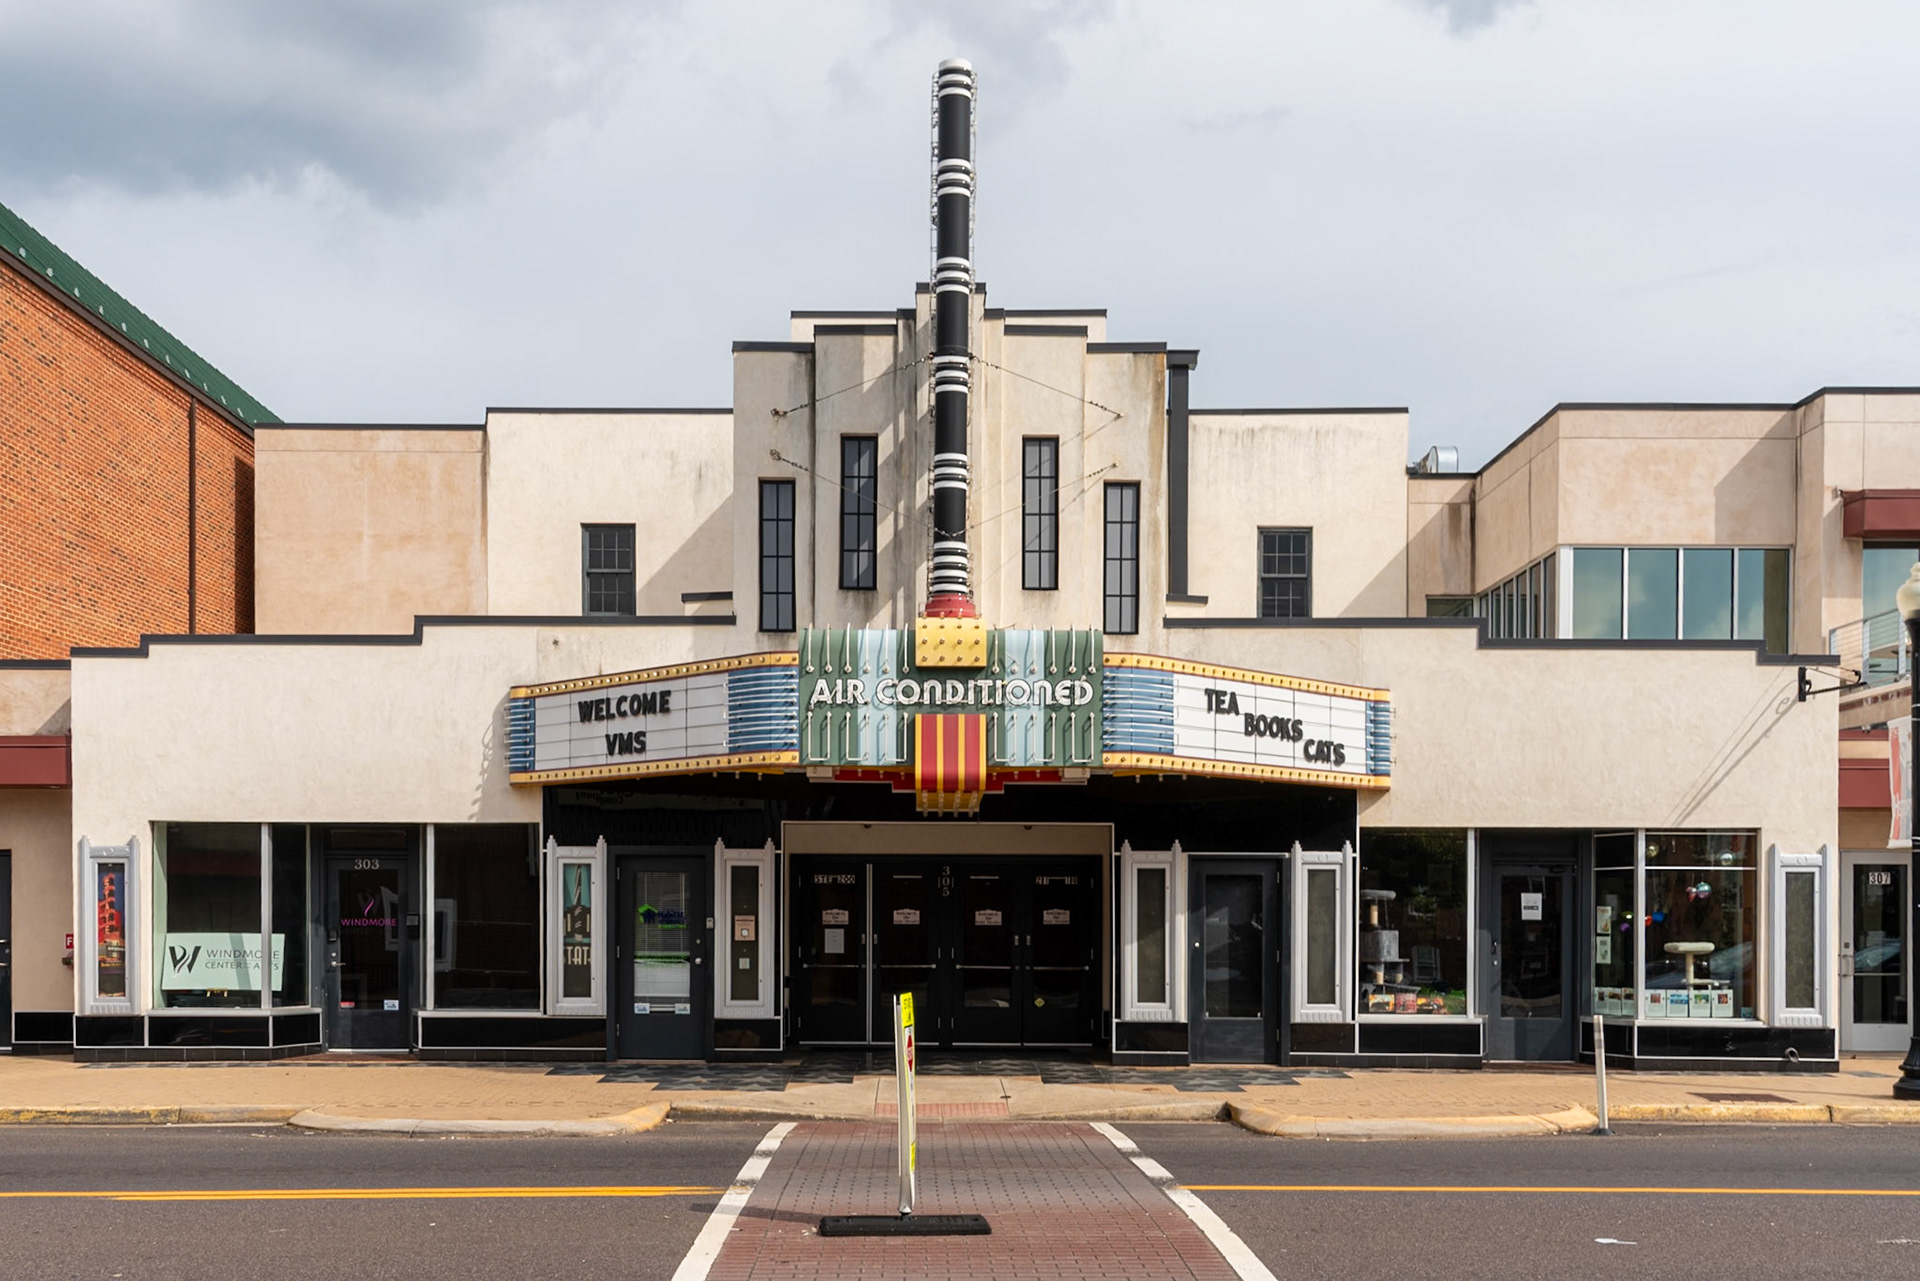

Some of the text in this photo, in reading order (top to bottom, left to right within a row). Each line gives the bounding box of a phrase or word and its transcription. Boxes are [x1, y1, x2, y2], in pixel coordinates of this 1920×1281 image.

[811, 678, 1094, 705] AIR CONDITIONED
[1204, 688, 1240, 716] TEA
[577, 690, 672, 723] WELCOME
[1244, 712, 1304, 743] BOOKS
[605, 731, 647, 757] VMS
[1303, 738, 1346, 767] CATS
[354, 859, 380, 870] 303
[942, 866, 950, 897] 305
[1870, 872, 1890, 884] 307
[341, 918, 397, 927] WINDMORE
[205, 961, 242, 970] CENTER
[253, 962, 280, 971] AS
[206, 949, 280, 960] WINDMOE
